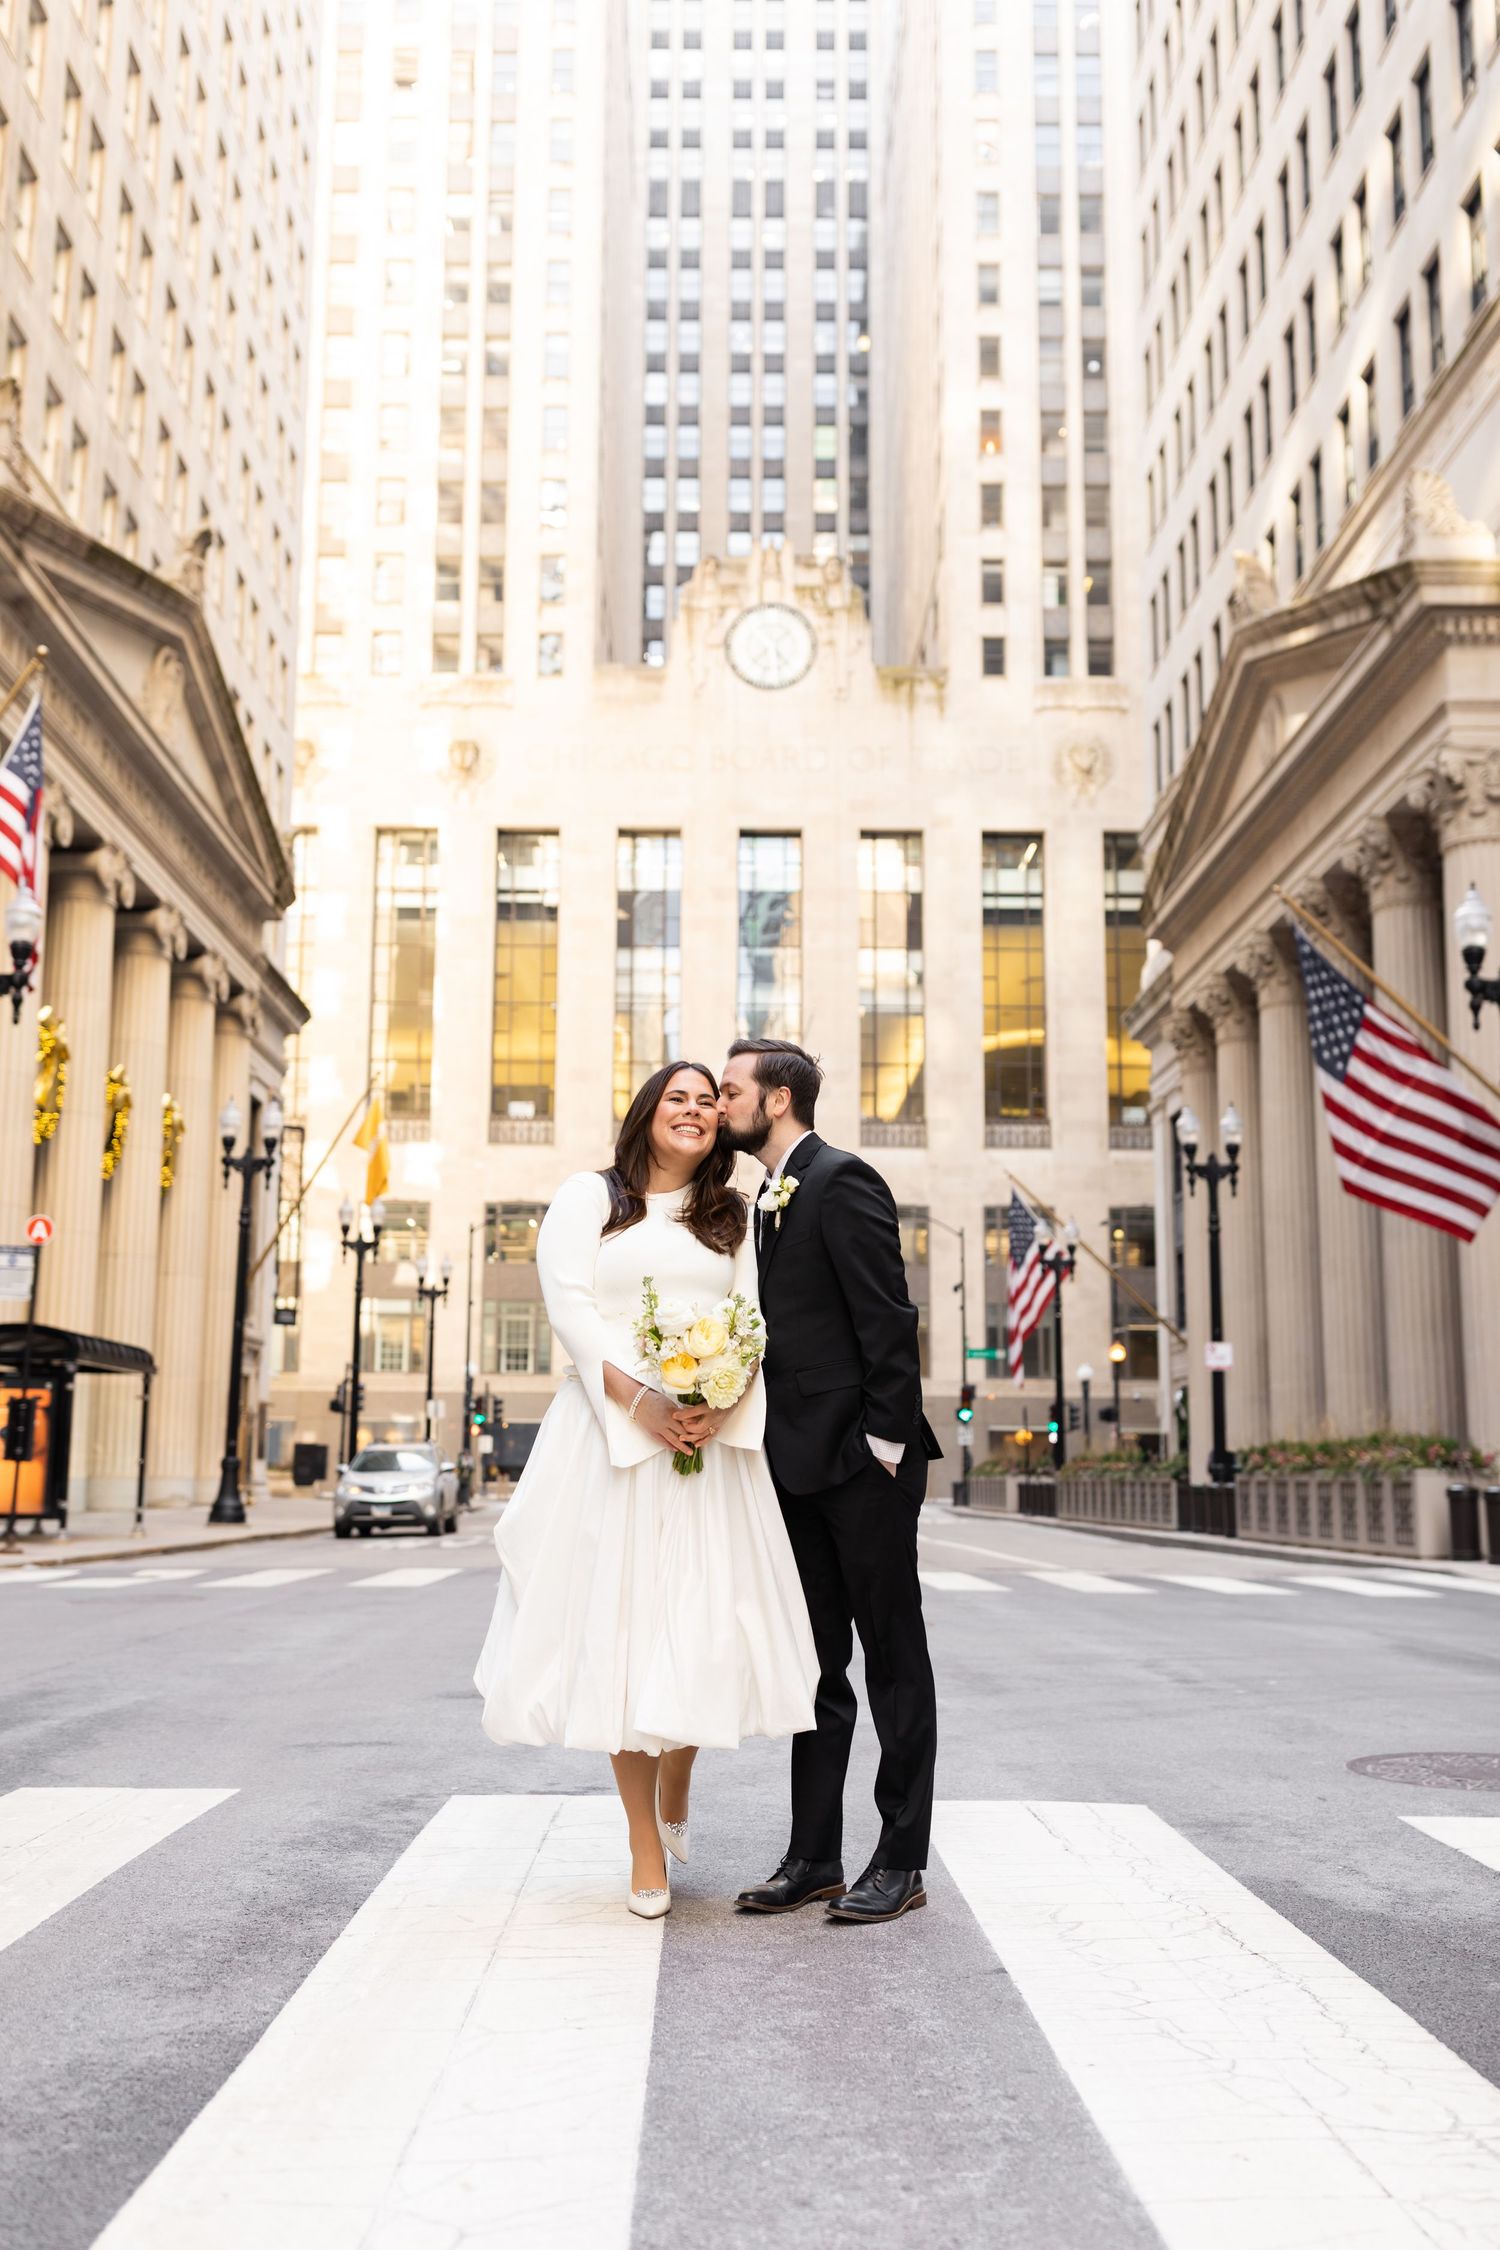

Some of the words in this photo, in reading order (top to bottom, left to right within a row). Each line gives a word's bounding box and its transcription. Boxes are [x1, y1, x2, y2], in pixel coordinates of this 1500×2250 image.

[524, 743, 695, 773] CHICAGO
[710, 743, 832, 773] BOARD
[847, 744, 892, 773] OF
[911, 744, 1024, 774] TADE
